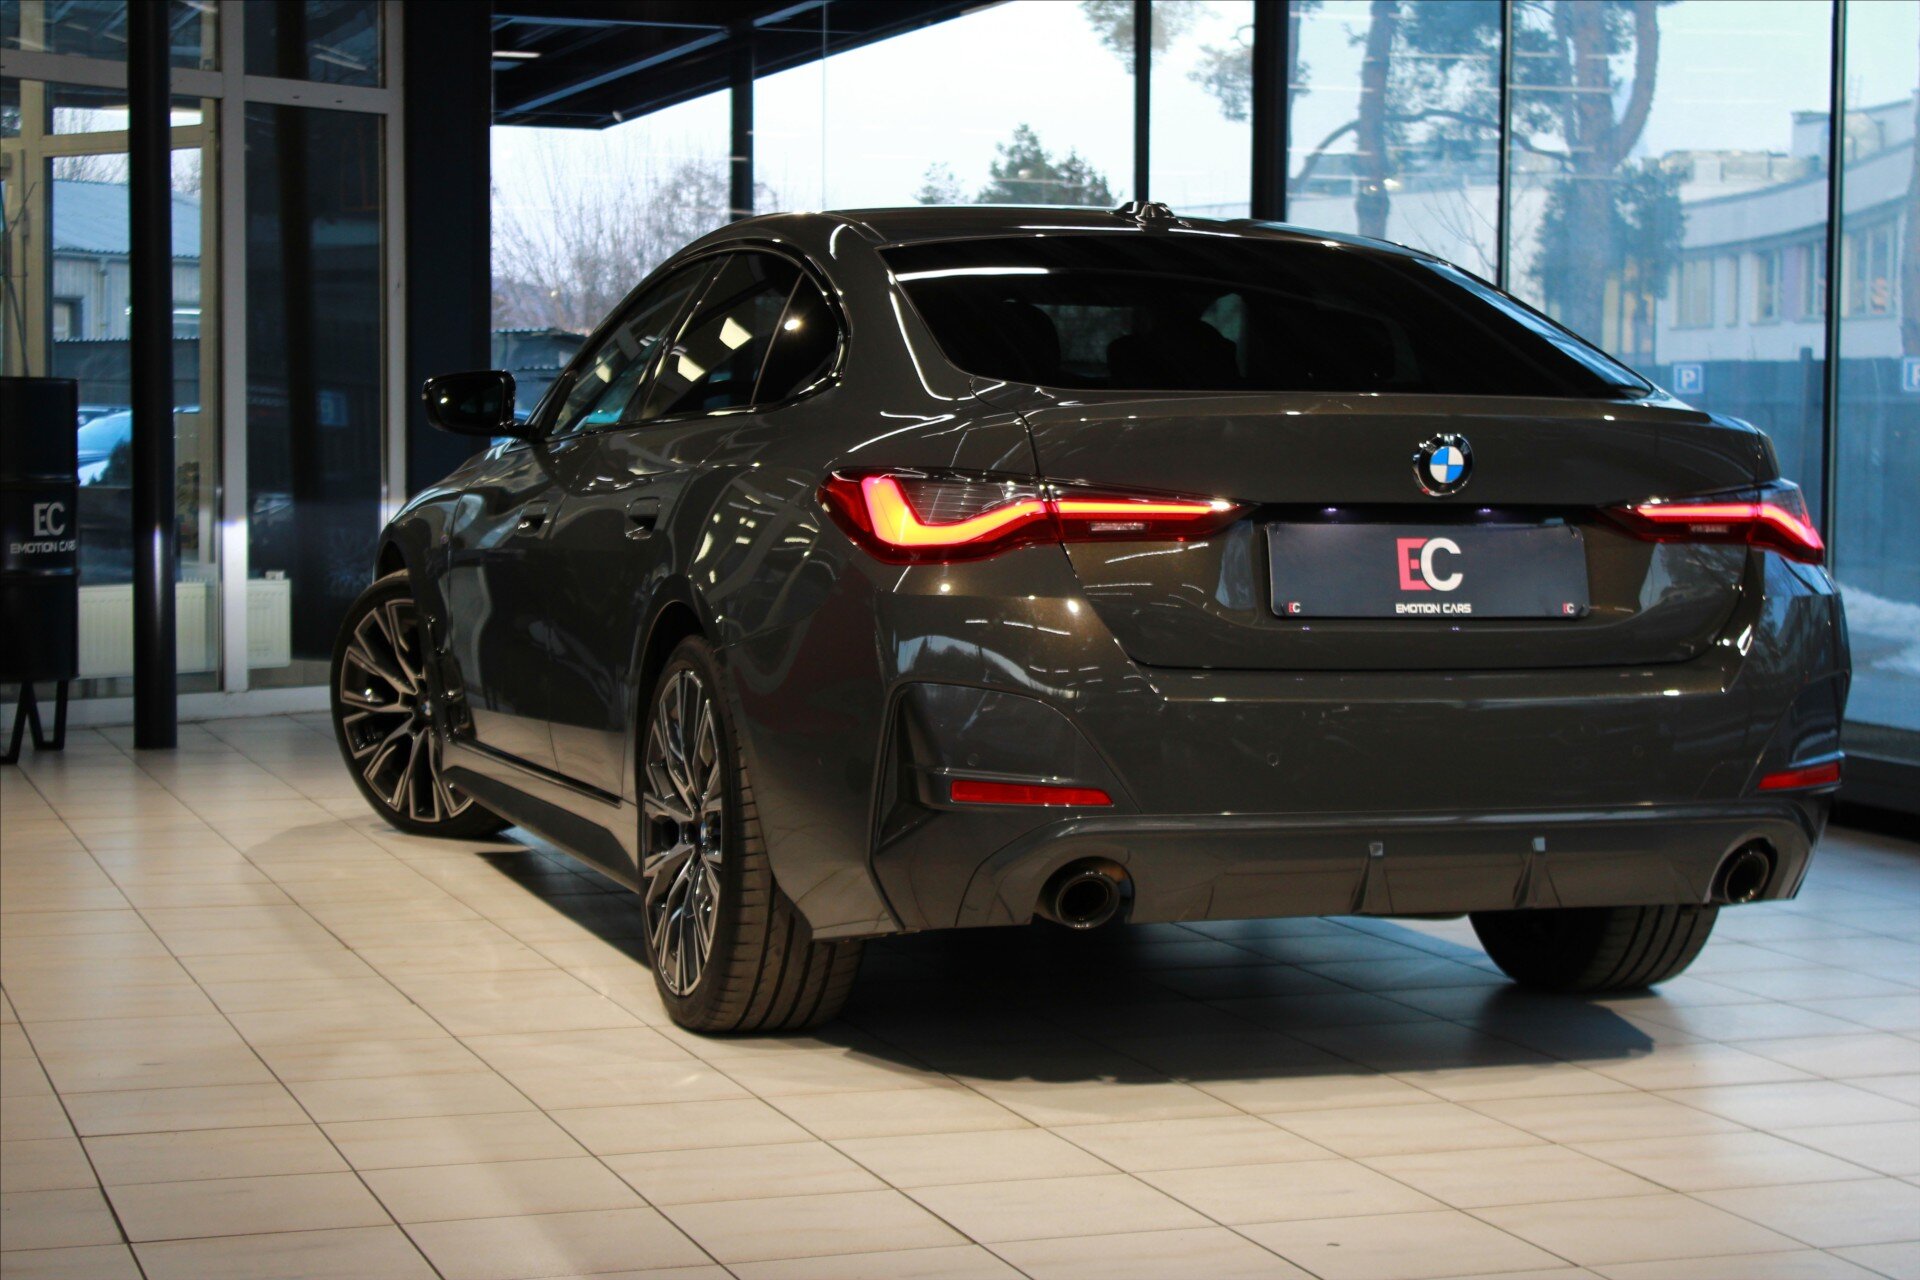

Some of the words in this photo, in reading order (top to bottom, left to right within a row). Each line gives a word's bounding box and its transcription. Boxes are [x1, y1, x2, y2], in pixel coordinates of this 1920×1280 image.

[1681, 370, 1696, 389] P
[33, 502, 66, 536] EC
[10, 542, 57, 554] EMOTION
[1396, 537, 1463, 591] EC
[1288, 602, 1301, 613] EC
[1395, 603, 1440, 614] EMOTION
[1442, 603, 1472, 614] CARS
